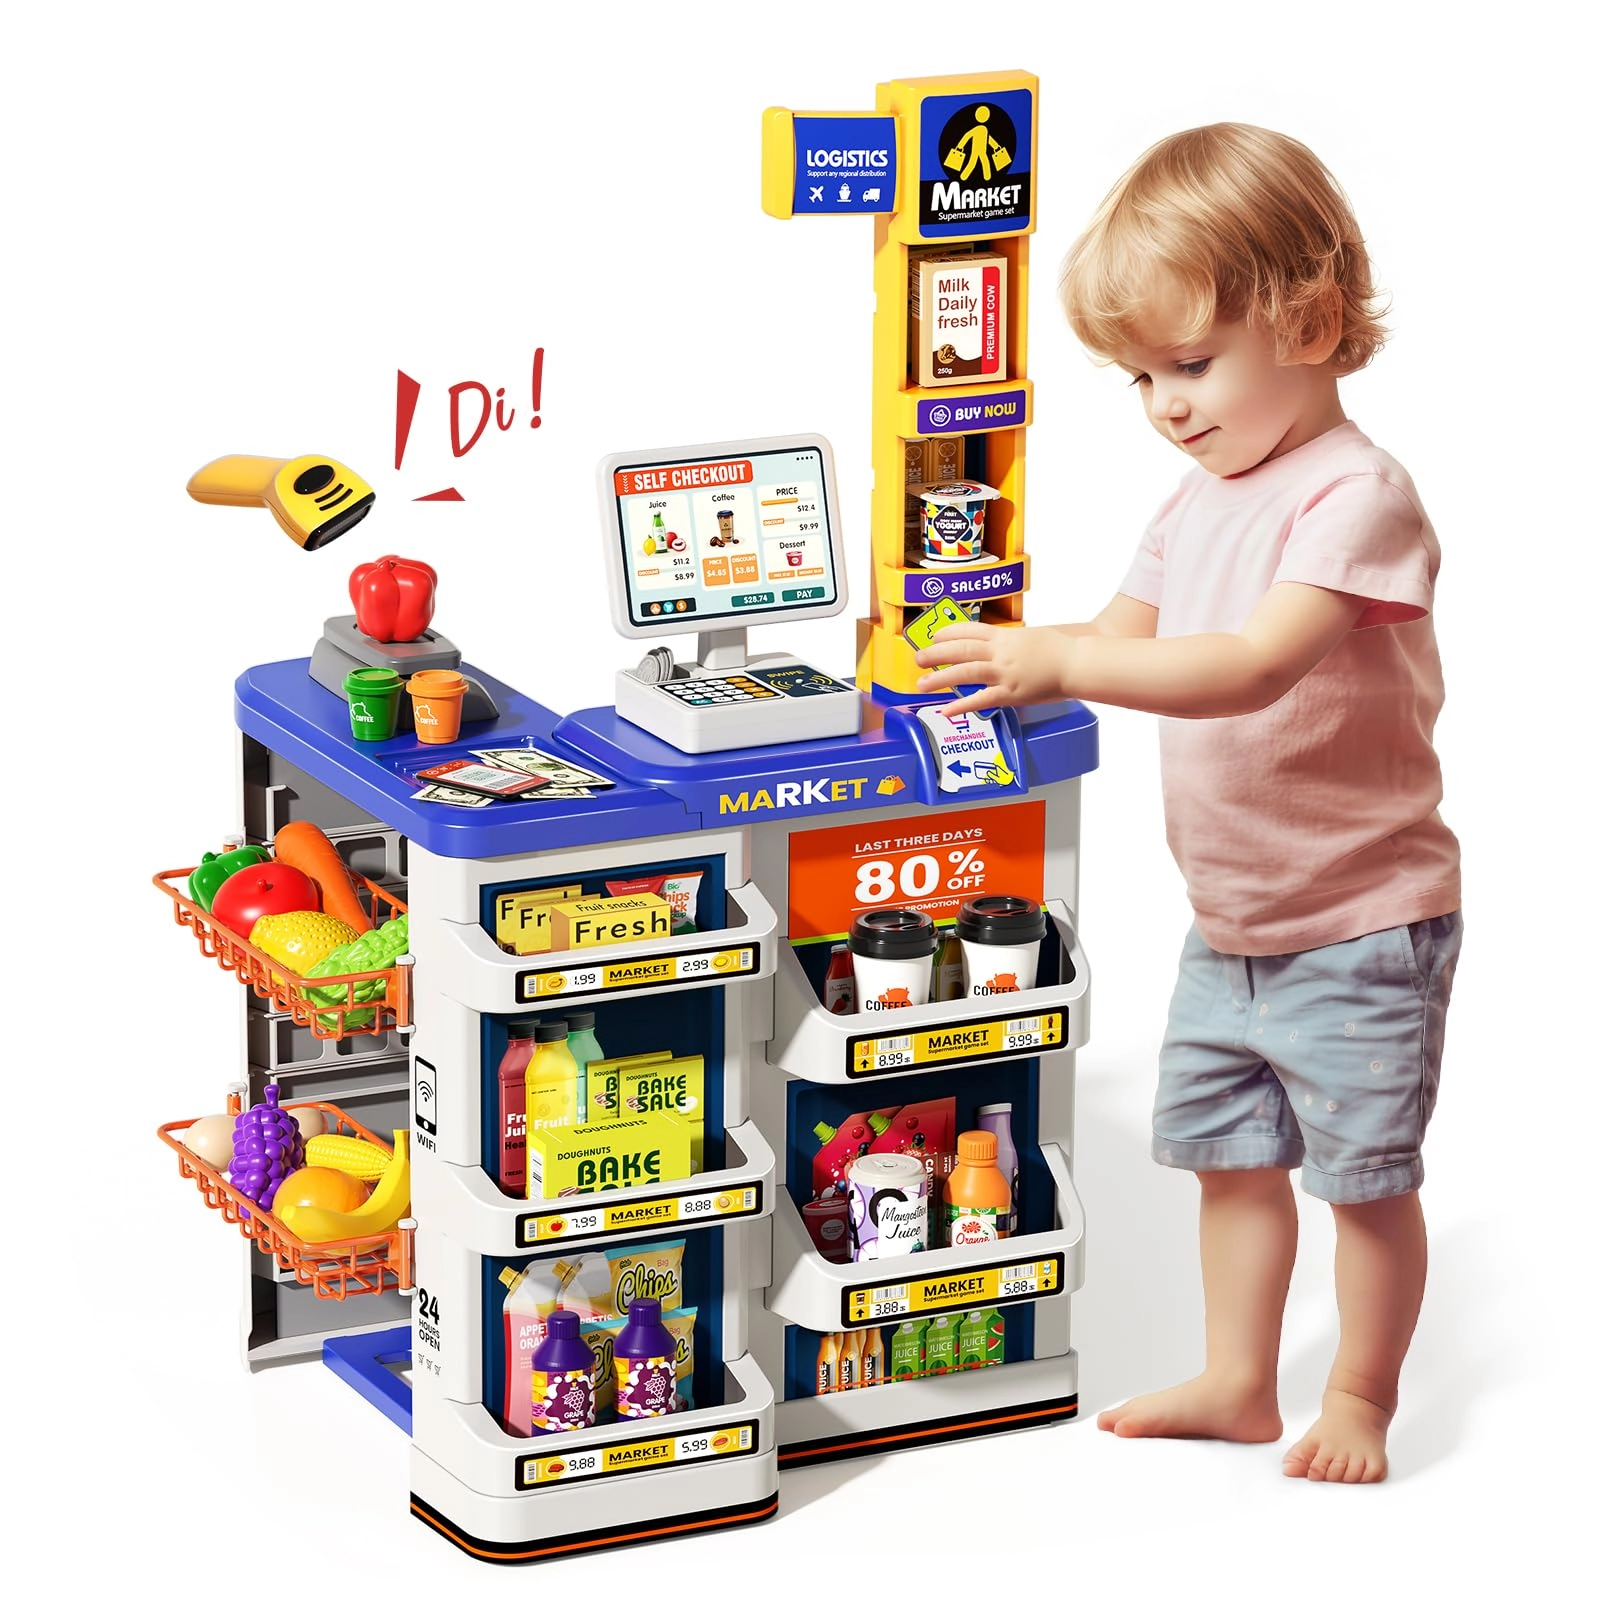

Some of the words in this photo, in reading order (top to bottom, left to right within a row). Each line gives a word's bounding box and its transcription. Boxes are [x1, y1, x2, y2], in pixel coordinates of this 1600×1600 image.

[806, 149, 889, 168] LOGISTICS
[807, 170, 828, 178] Support
[839, 170, 858, 178] regional
[931, 181, 1022, 211] MARKET
[938, 209, 983, 222] Supermarket
[985, 207, 1004, 219] game
[1005, 207, 1015, 215] set
[938, 278, 970, 293] Milk
[938, 296, 978, 312] Daily
[987, 285, 995, 310] COW
[938, 314, 978, 329] fresh
[987, 312, 995, 360] PREMIUM
[938, 367, 953, 375] 250g
[955, 406, 982, 421] BUY
[984, 402, 1017, 417] NOW
[633, 471, 667, 491] SELF
[671, 463, 746, 488] CHECKOUT
[711, 493, 735, 503] Coffee
[775, 487, 798, 496] PRICE
[648, 500, 667, 509] Juice
[797, 504, 816, 513] $12.4
[799, 522, 819, 531] $9.99
[779, 540, 806, 549] Dessert
[673, 557, 690, 566] $11.2
[674, 572, 695, 581] $8.99
[743, 594, 768, 604] $28.74
[796, 590, 813, 599] PAY
[355, 715, 374, 723] COFFEE
[943, 731, 986, 744] MERCHANDISE
[941, 739, 995, 755] CHECKOUT
[719, 777, 869, 815] MARKET
[855, 839, 892, 853] LAST
[894, 833, 939, 848] THREE
[942, 828, 983, 842] DAYS
[947, 874, 985, 890] OFF
[576, 903, 604, 912] Fruit
[606, 899, 647, 910] snacks
[661, 891, 690, 906] hips
[575, 911, 668, 944] Fresh
[609, 963, 669, 979] MARKET
[682, 959, 709, 972] 2.99
[928, 1029, 989, 1048] MARKET
[1008, 1034, 1033, 1048] 9.99
[928, 1044, 963, 1054] Supermarket
[964, 1042, 980, 1050] game
[879, 1052, 903, 1066] 8.99
[626, 1072, 658, 1081] DOUGHNUTS
[637, 1074, 686, 1096] BAKE
[637, 1090, 686, 1113] SALE
[534, 1116, 569, 1130] Fruit
[573, 1120, 647, 1134] DOUGHNUTS
[417, 1132, 436, 1153] WIFI
[557, 1146, 611, 1160] DOUGHNUTS
[577, 1150, 660, 1186] BAKE
[611, 1205, 671, 1220] MARKET
[684, 1199, 711, 1213] 8.88
[571, 1215, 597, 1229] 7.99
[885, 1223, 921, 1239] Juice
[616, 1263, 679, 1316] Chips
[924, 1277, 984, 1297] MARKET
[1004, 1280, 1028, 1295] 5.88
[923, 1292, 959, 1302] Supermarket
[419, 1288, 440, 1326] 24
[875, 1302, 899, 1316] 3.88
[419, 1318, 440, 1340] HOURS
[520, 1323, 547, 1338] APPE
[419, 1329, 440, 1352] OPEN
[928, 1342, 952, 1354] JUICE
[962, 1336, 986, 1348] JUICE
[894, 1347, 918, 1360] JUICE
[841, 1360, 850, 1389] UICE
[645, 1396, 665, 1406] GRAPE
[564, 1409, 584, 1419] GRAPE
[609, 1444, 668, 1461] MARKET
[681, 1438, 708, 1454] 5.99
[569, 1456, 595, 1471] 9.88
